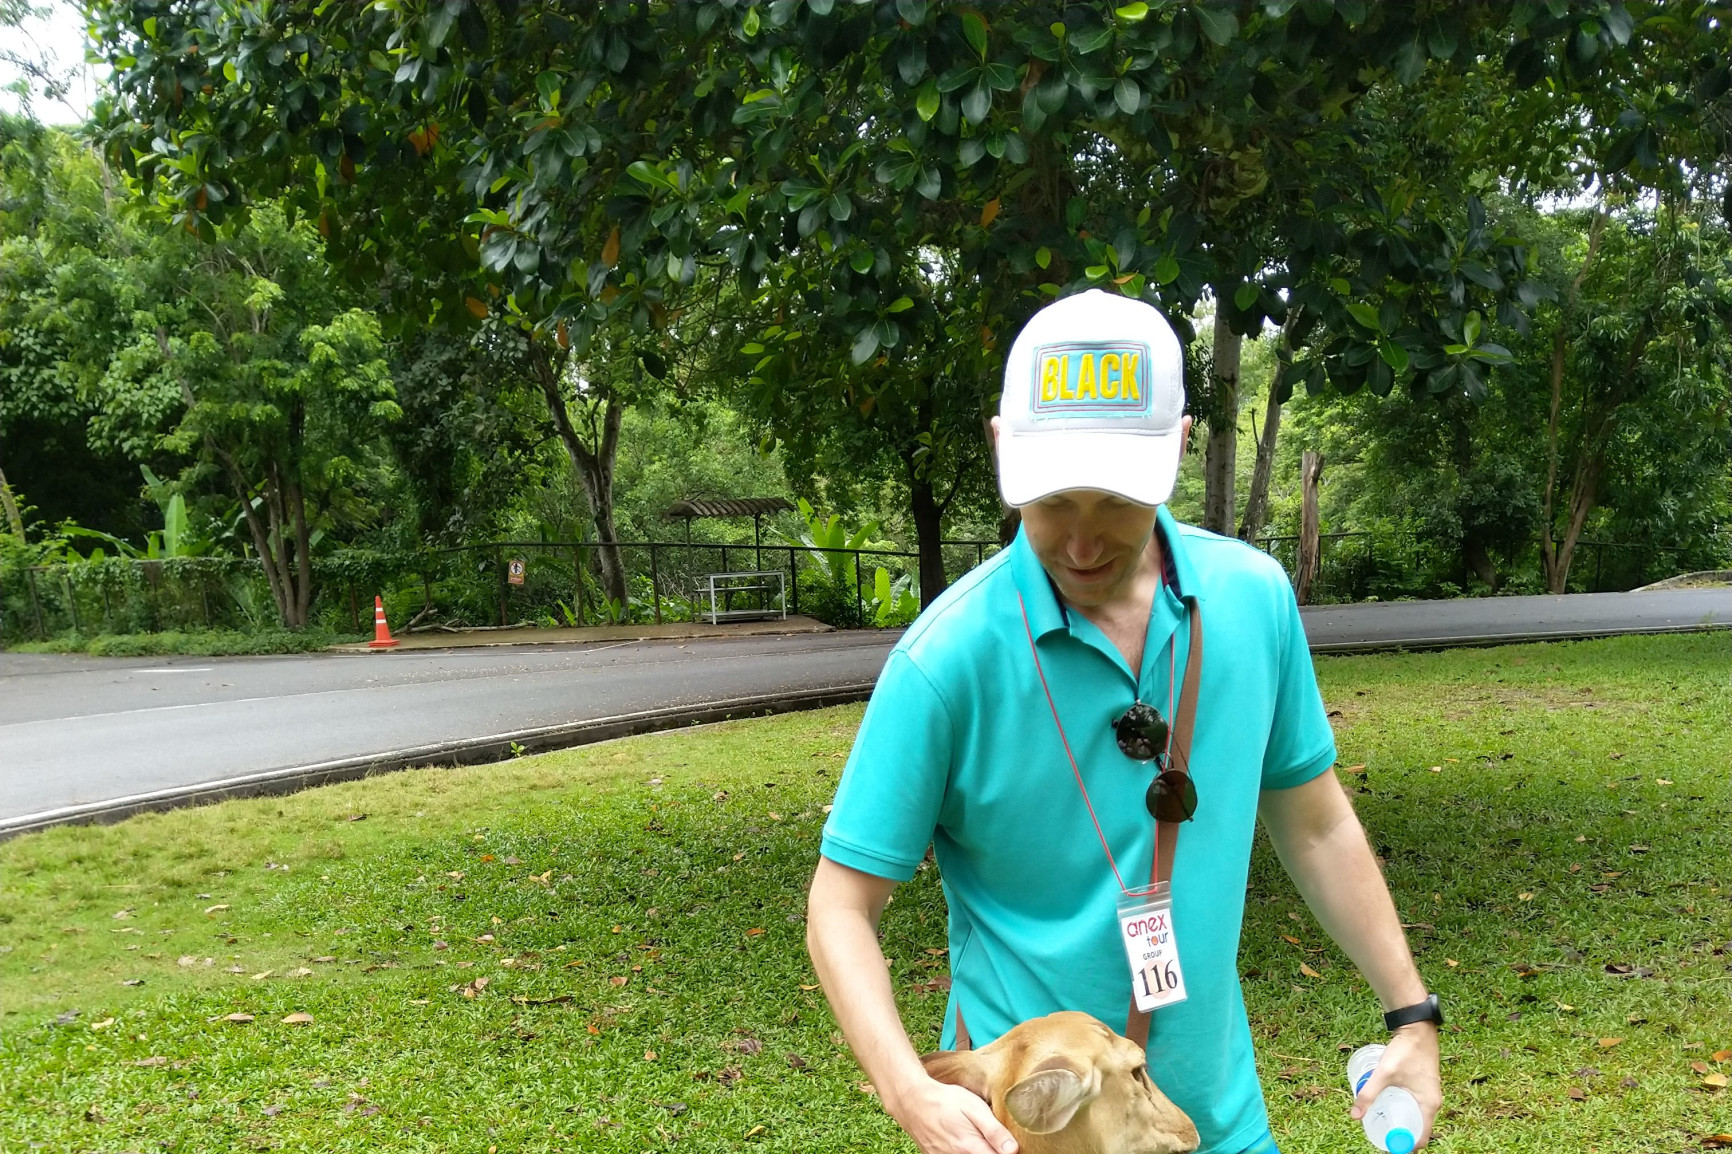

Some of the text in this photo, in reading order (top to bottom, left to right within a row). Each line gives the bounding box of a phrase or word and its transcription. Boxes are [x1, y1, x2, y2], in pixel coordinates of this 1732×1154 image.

[1041, 352, 1140, 402] BLACK
[1127, 914, 1167, 938] anex
[1146, 932, 1169, 947] tour
[1142, 949, 1163, 961] GROUP
[1138, 959, 1178, 997] 116
